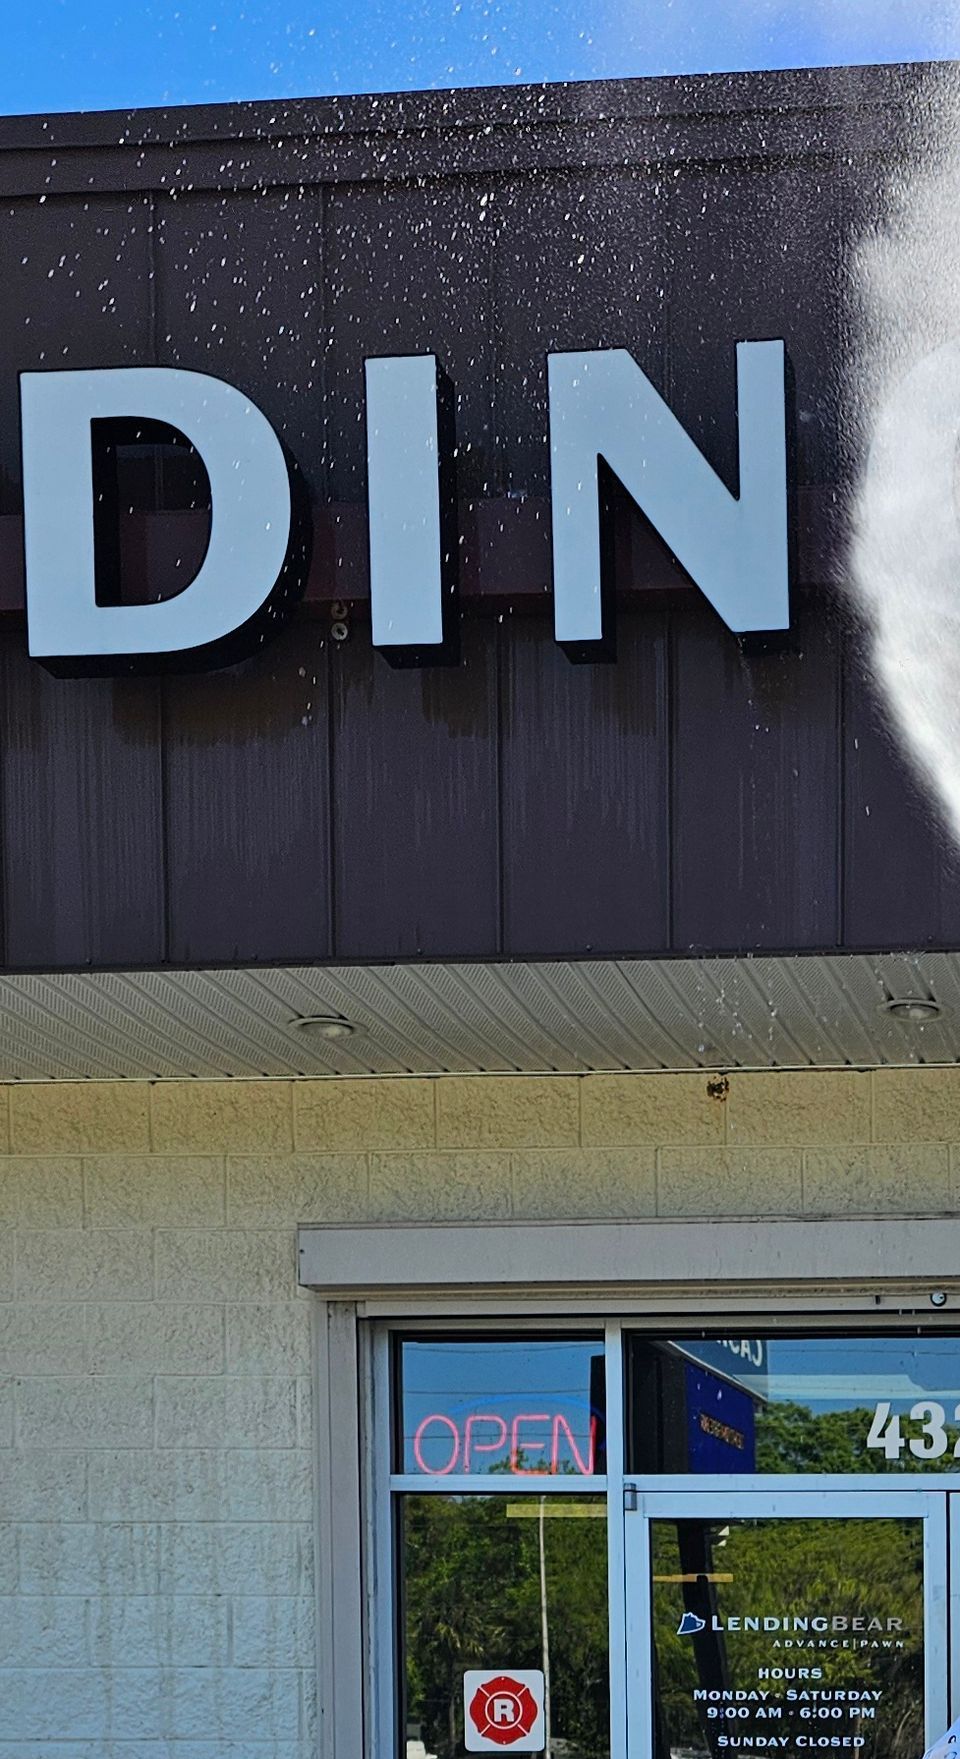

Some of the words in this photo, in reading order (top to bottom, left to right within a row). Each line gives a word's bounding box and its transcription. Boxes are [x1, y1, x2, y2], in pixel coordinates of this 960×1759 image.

[414, 1414, 597, 1475] OPEN
[711, 1615, 903, 1631] LENDINGBEAR
[758, 1668, 823, 1679] HOURS
[693, 1689, 769, 1701] MONDAY
[786, 1689, 883, 1701] SATURDAY
[493, 1699, 515, 1722] R
[707, 1707, 749, 1719] 9:00
[755, 1707, 782, 1719] AM
[800, 1707, 842, 1719] 6:00
[849, 1707, 875, 1719] PM
[718, 1736, 789, 1747] SUNDAY
[796, 1736, 865, 1747] CLOSED
